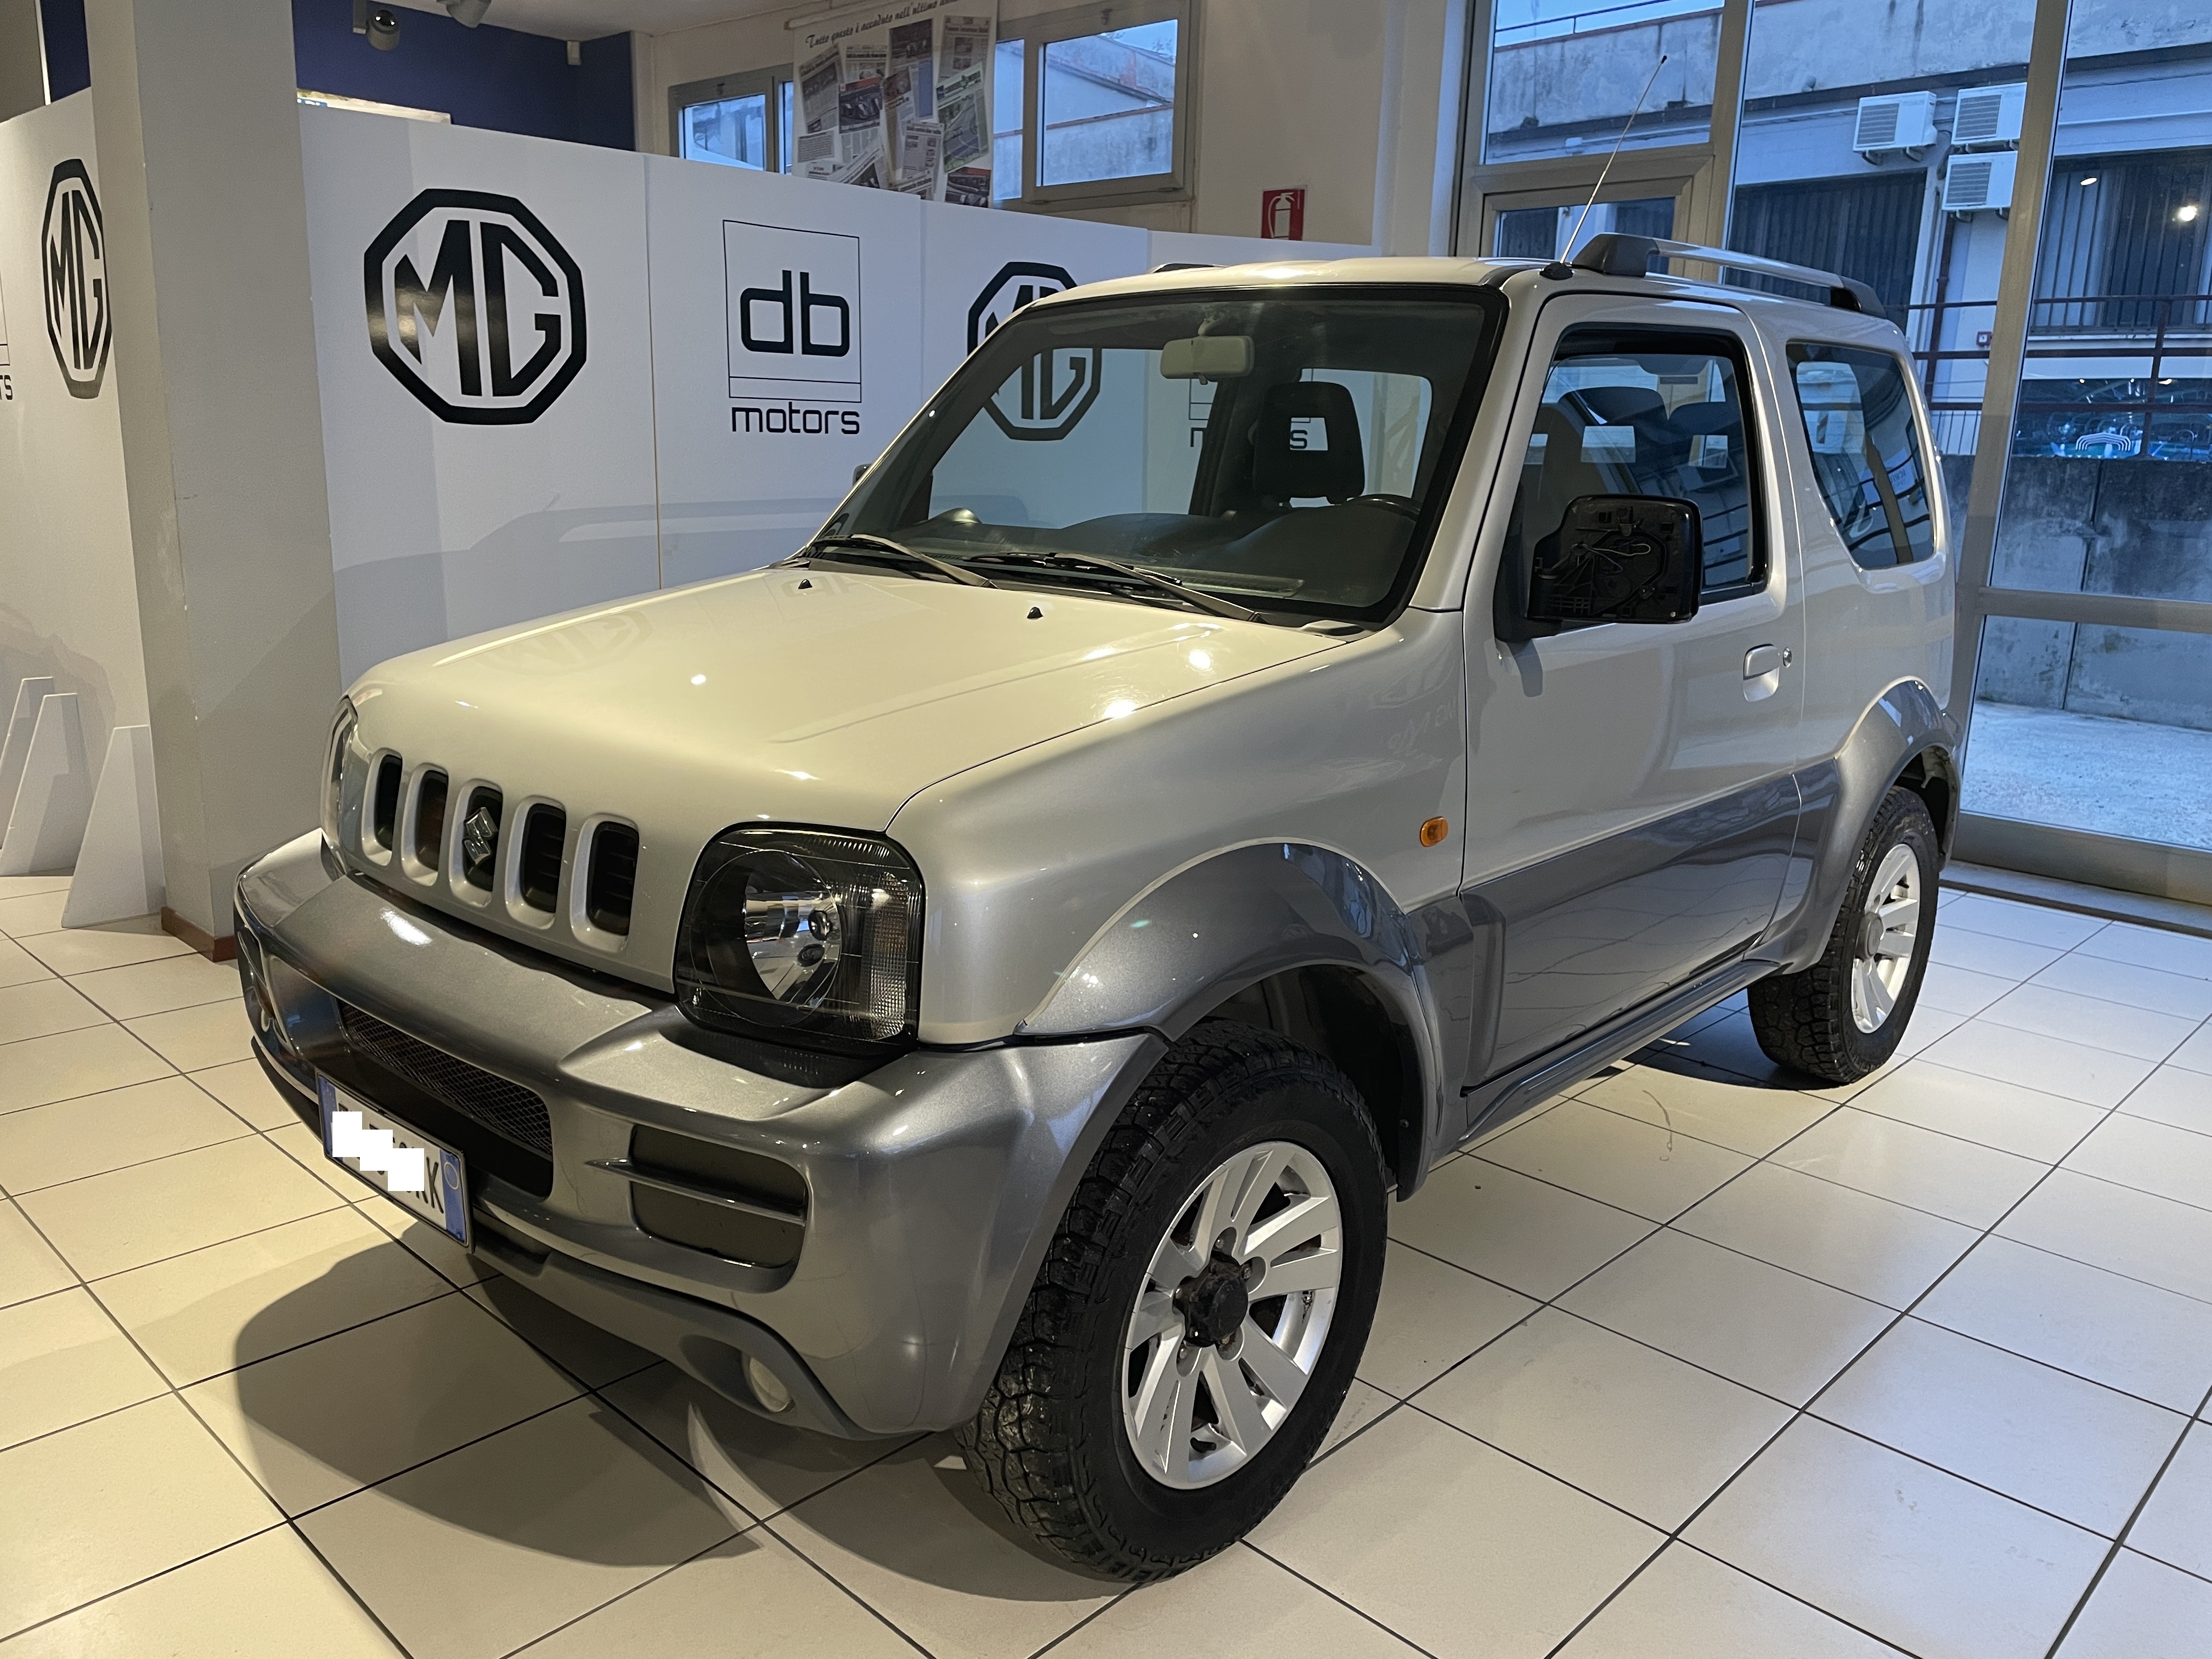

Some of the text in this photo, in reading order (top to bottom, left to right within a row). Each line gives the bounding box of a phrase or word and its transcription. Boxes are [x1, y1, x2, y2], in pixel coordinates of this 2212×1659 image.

[50, 189, 103, 370] MG
[394, 219, 562, 397] MG
[740, 269, 850, 357] db
[731, 401, 860, 435] motors
